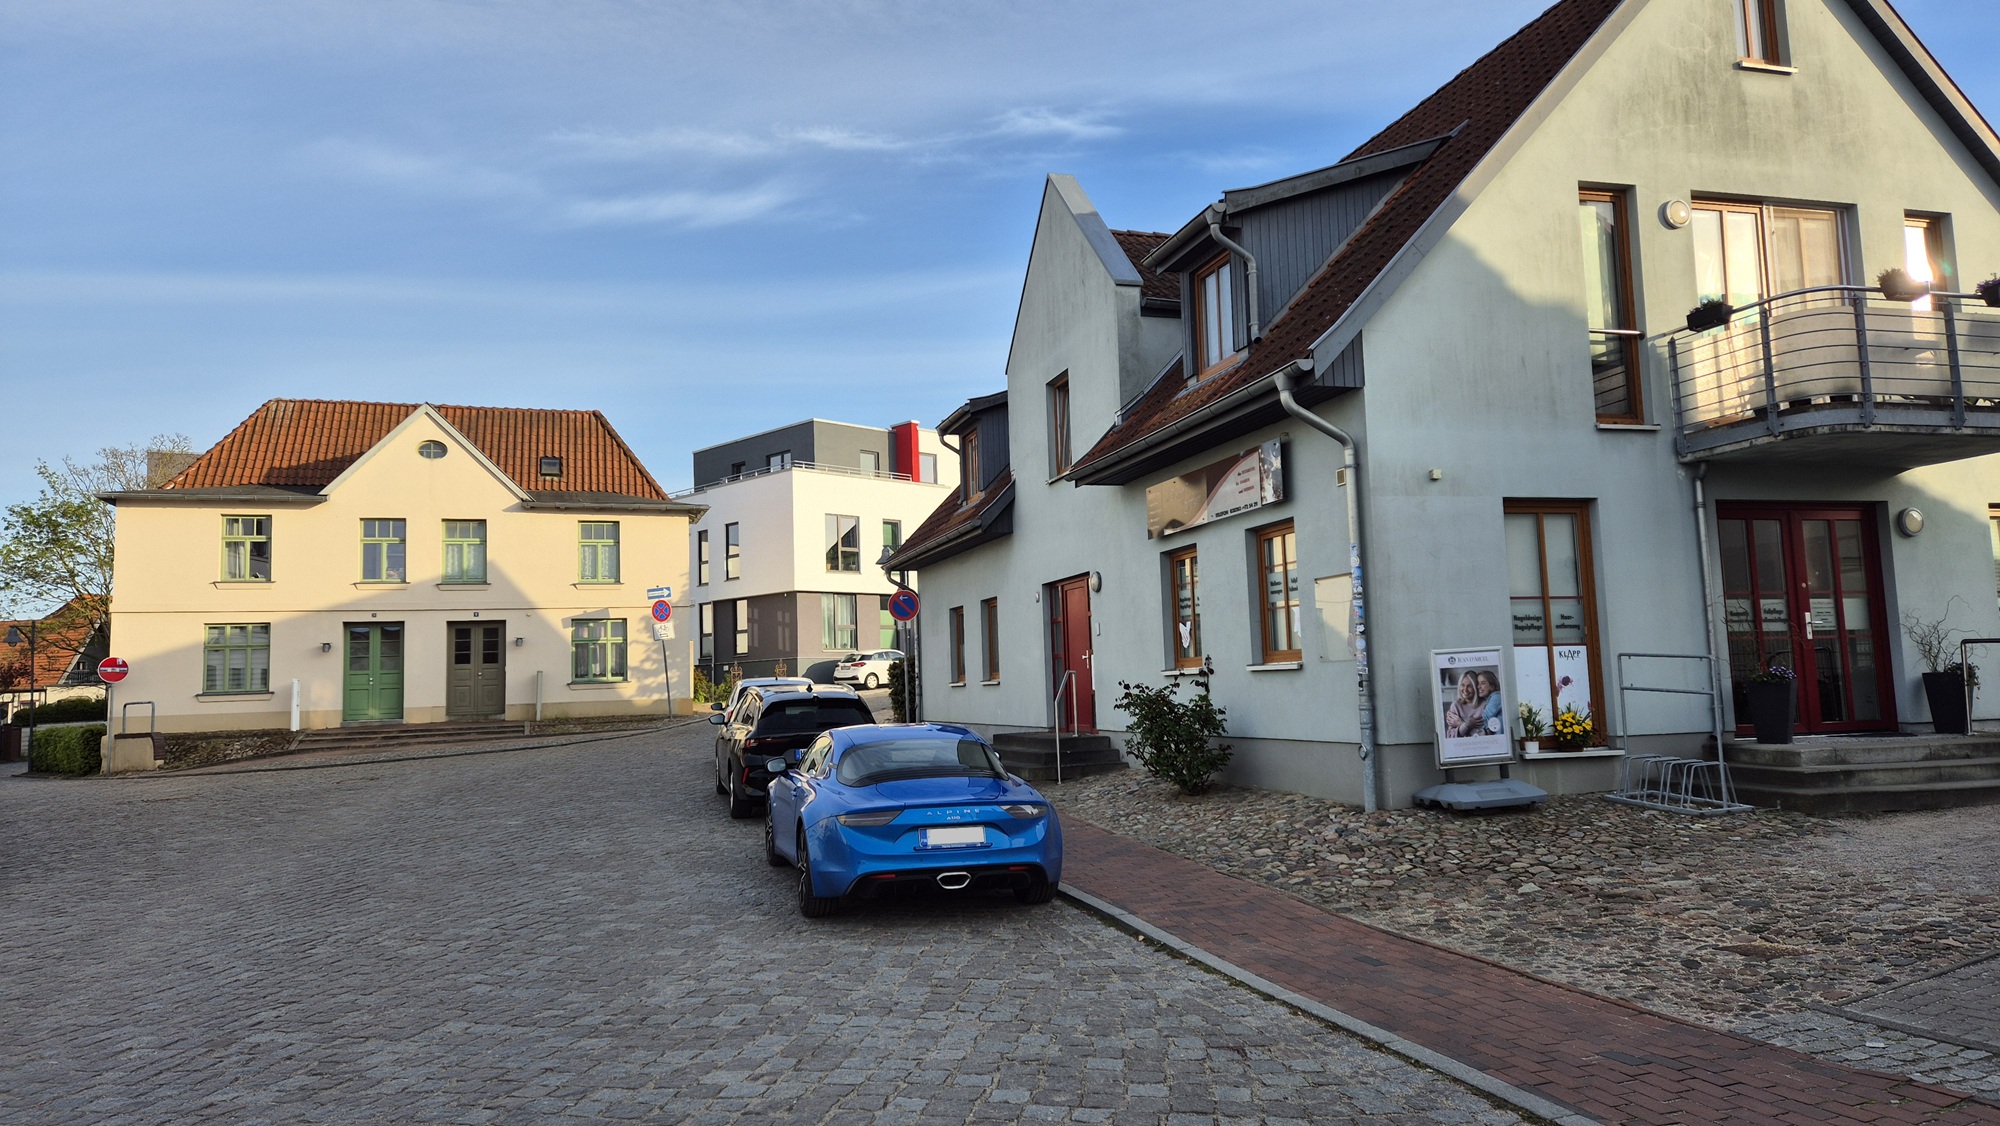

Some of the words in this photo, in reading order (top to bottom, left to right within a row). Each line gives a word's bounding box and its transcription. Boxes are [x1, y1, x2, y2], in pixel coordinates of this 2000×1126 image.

[1513, 614, 1542, 622] Nageldesign
[1514, 623, 1543, 631] Nagelpflege
[1558, 649, 1581, 661] KLAPP
[926, 808, 980, 816] ALPINE
